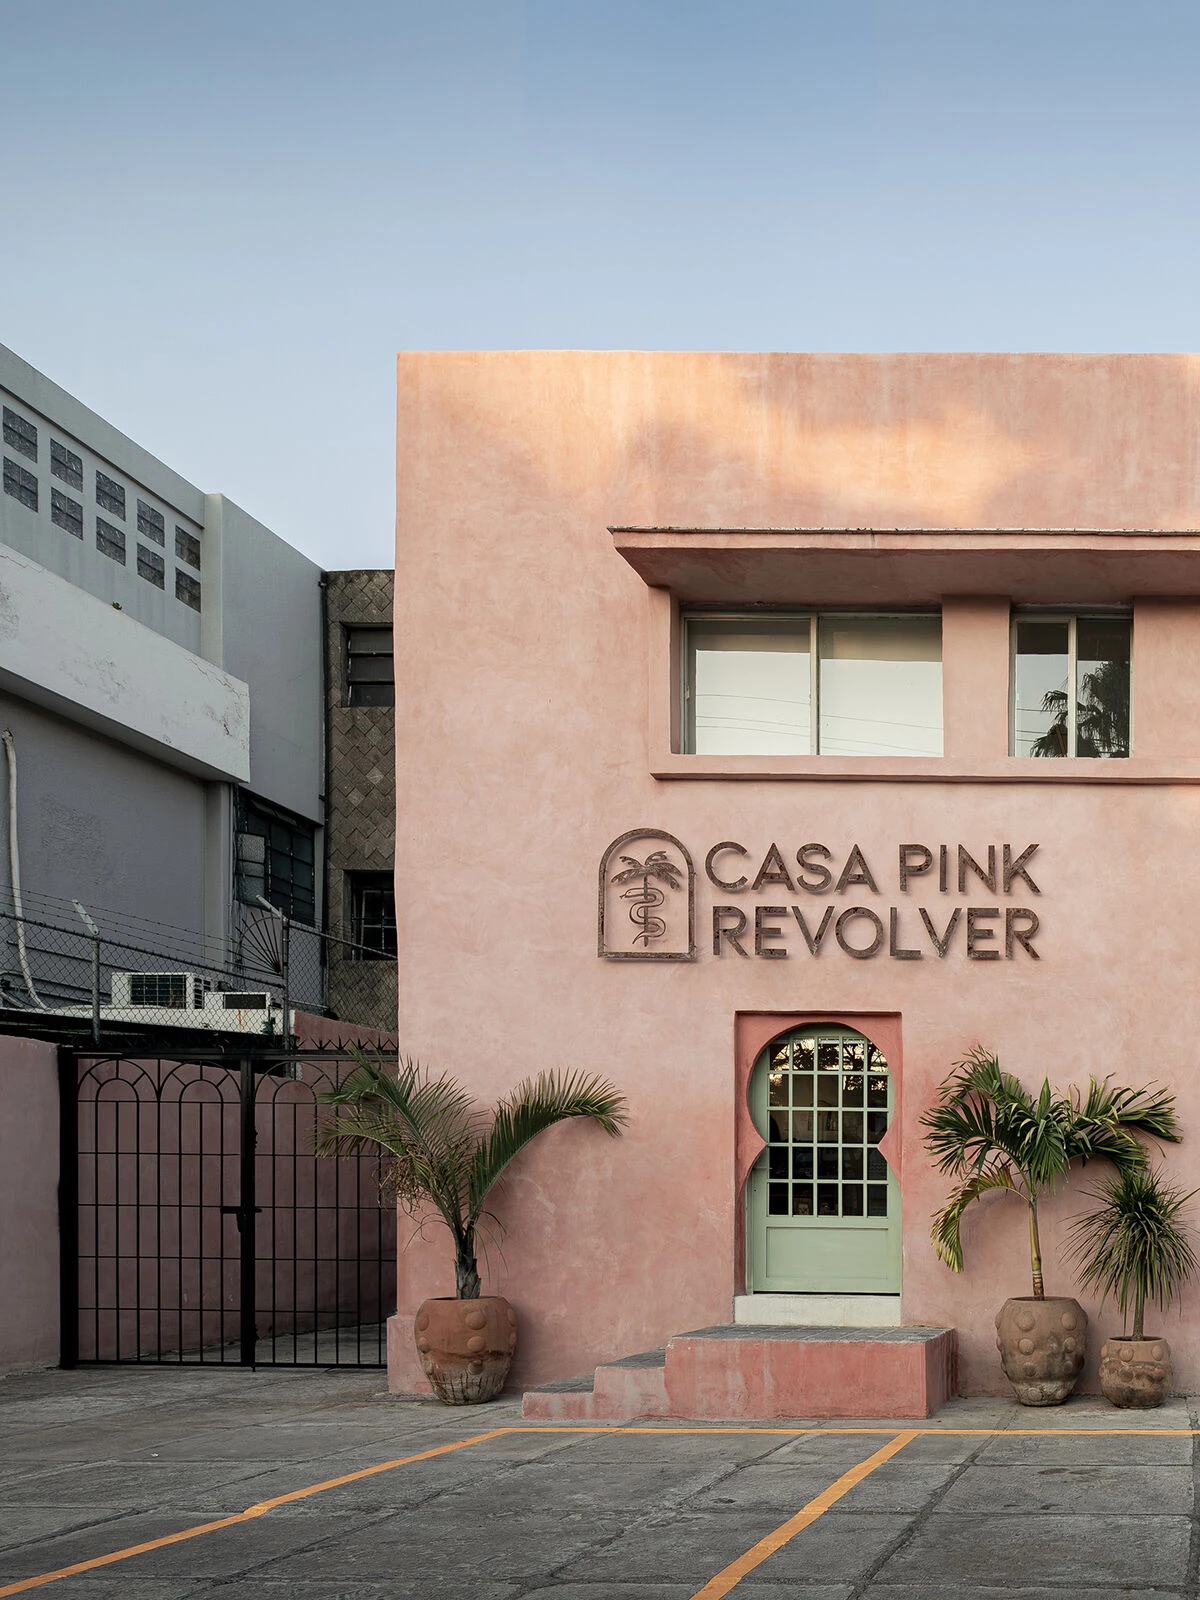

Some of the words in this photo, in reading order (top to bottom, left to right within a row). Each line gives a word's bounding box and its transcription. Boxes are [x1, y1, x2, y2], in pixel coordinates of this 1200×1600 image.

[704, 840, 880, 895] CASA
[899, 843, 1042, 895] PINK
[713, 905, 1042, 961] REVOLVER
